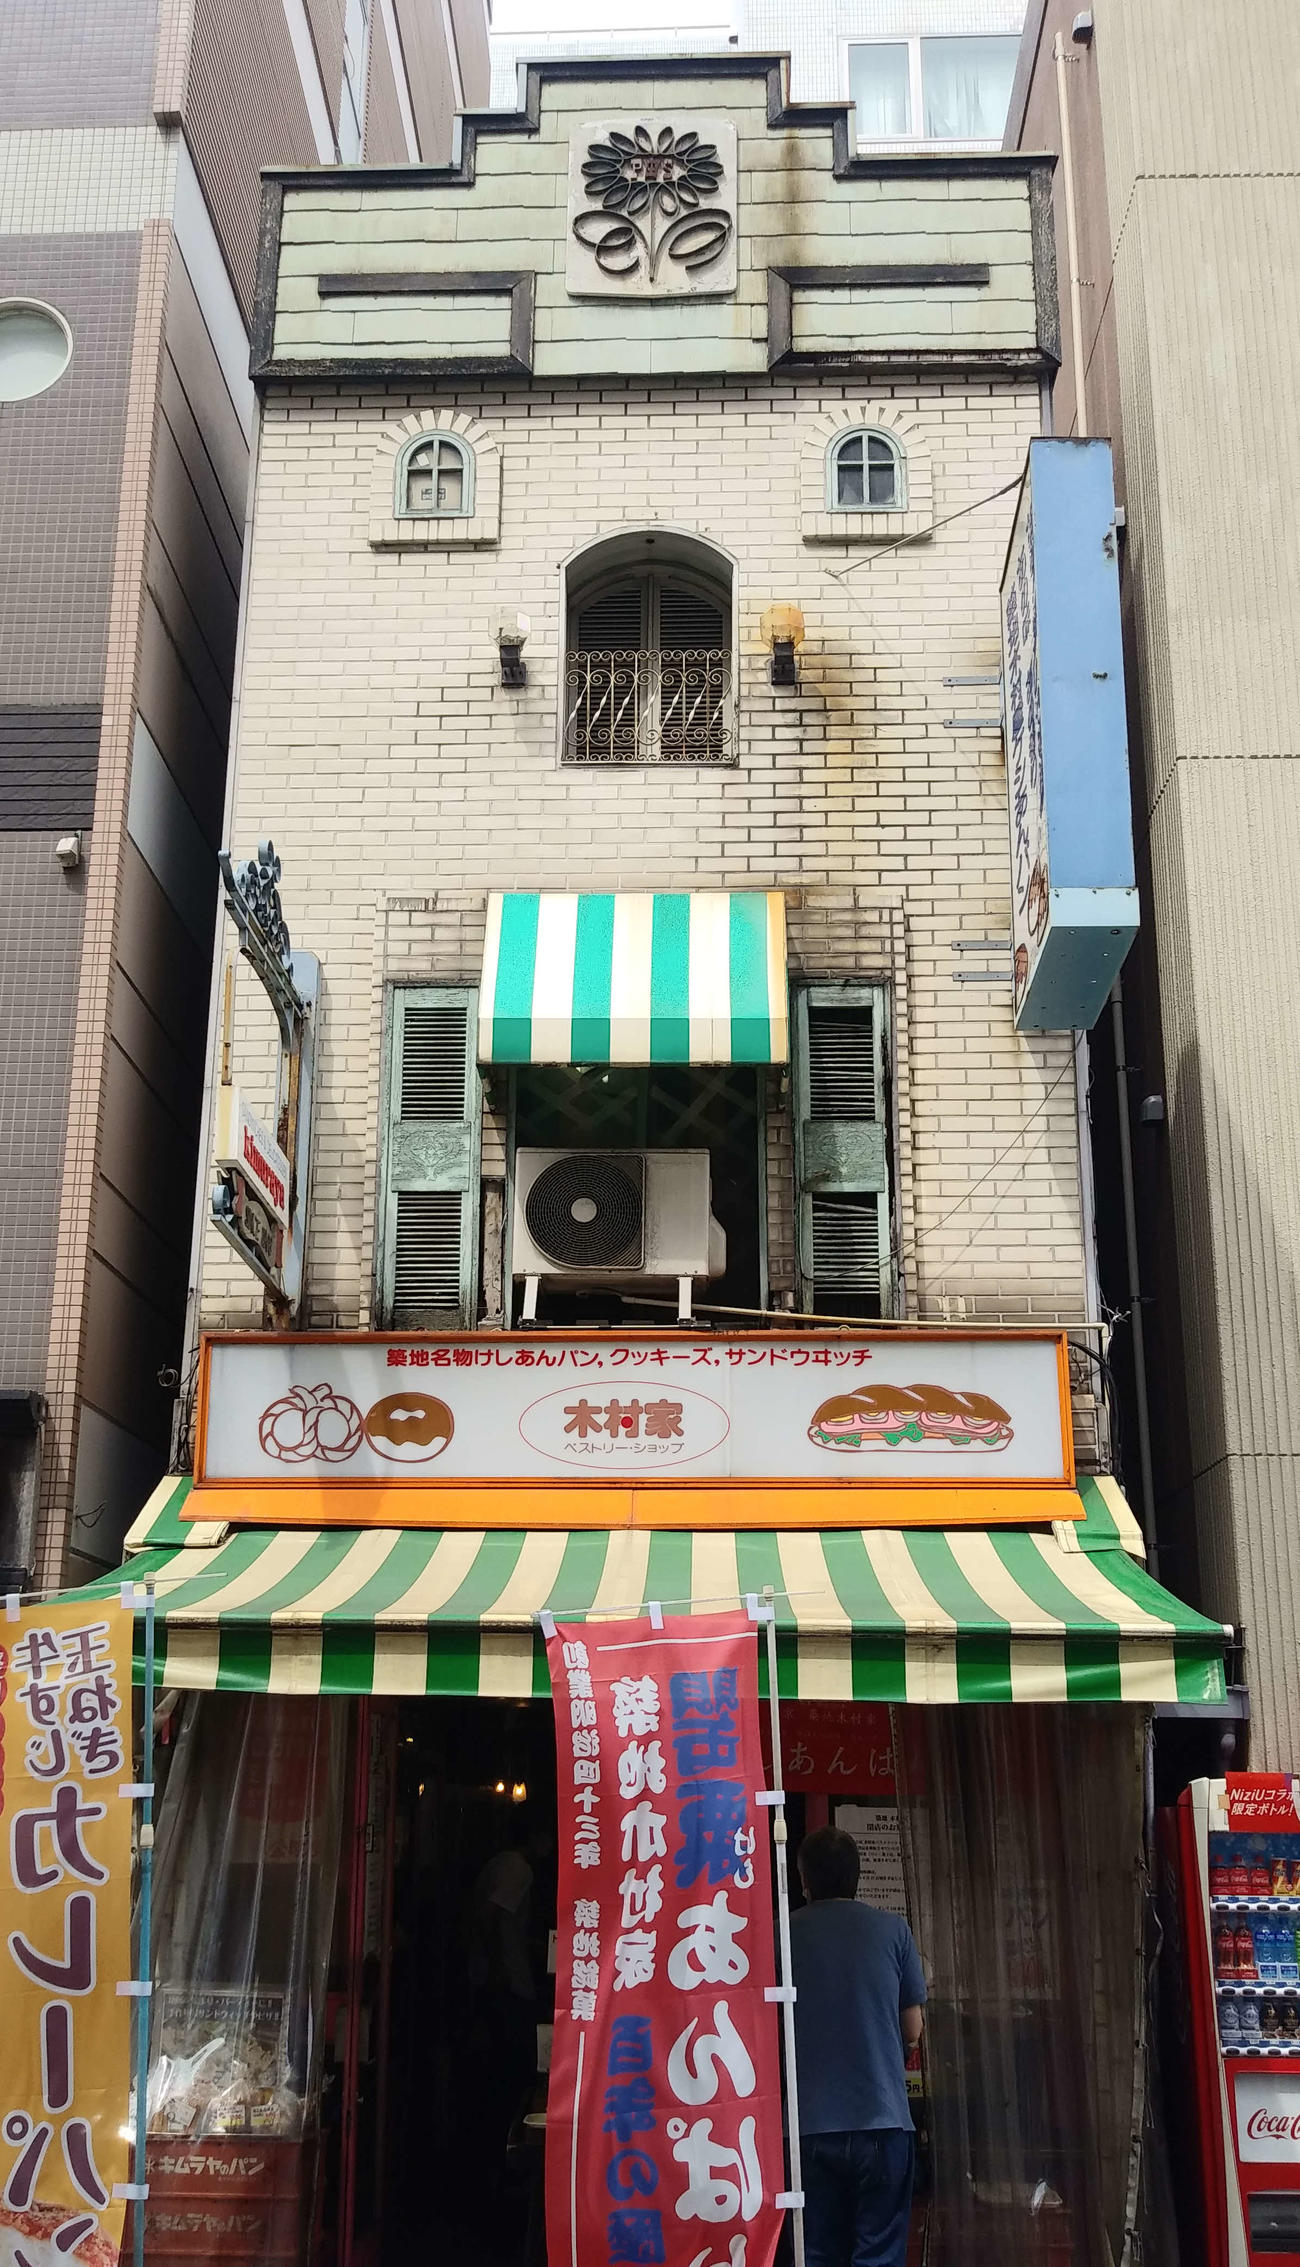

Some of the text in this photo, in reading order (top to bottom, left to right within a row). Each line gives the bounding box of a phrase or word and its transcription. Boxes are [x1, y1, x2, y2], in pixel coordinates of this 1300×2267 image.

[563, 1398, 684, 1438] 木村家
[564, 1441, 685, 1455] ペストリー・ショップ
[1231, 1802, 1294, 1817] 限定ボトル!
[866, 1823, 901, 1833] 閉店のお
[159, 2155, 265, 2176] キムラヤのパン
[155, 2212, 263, 2233] キムラヤのパン
